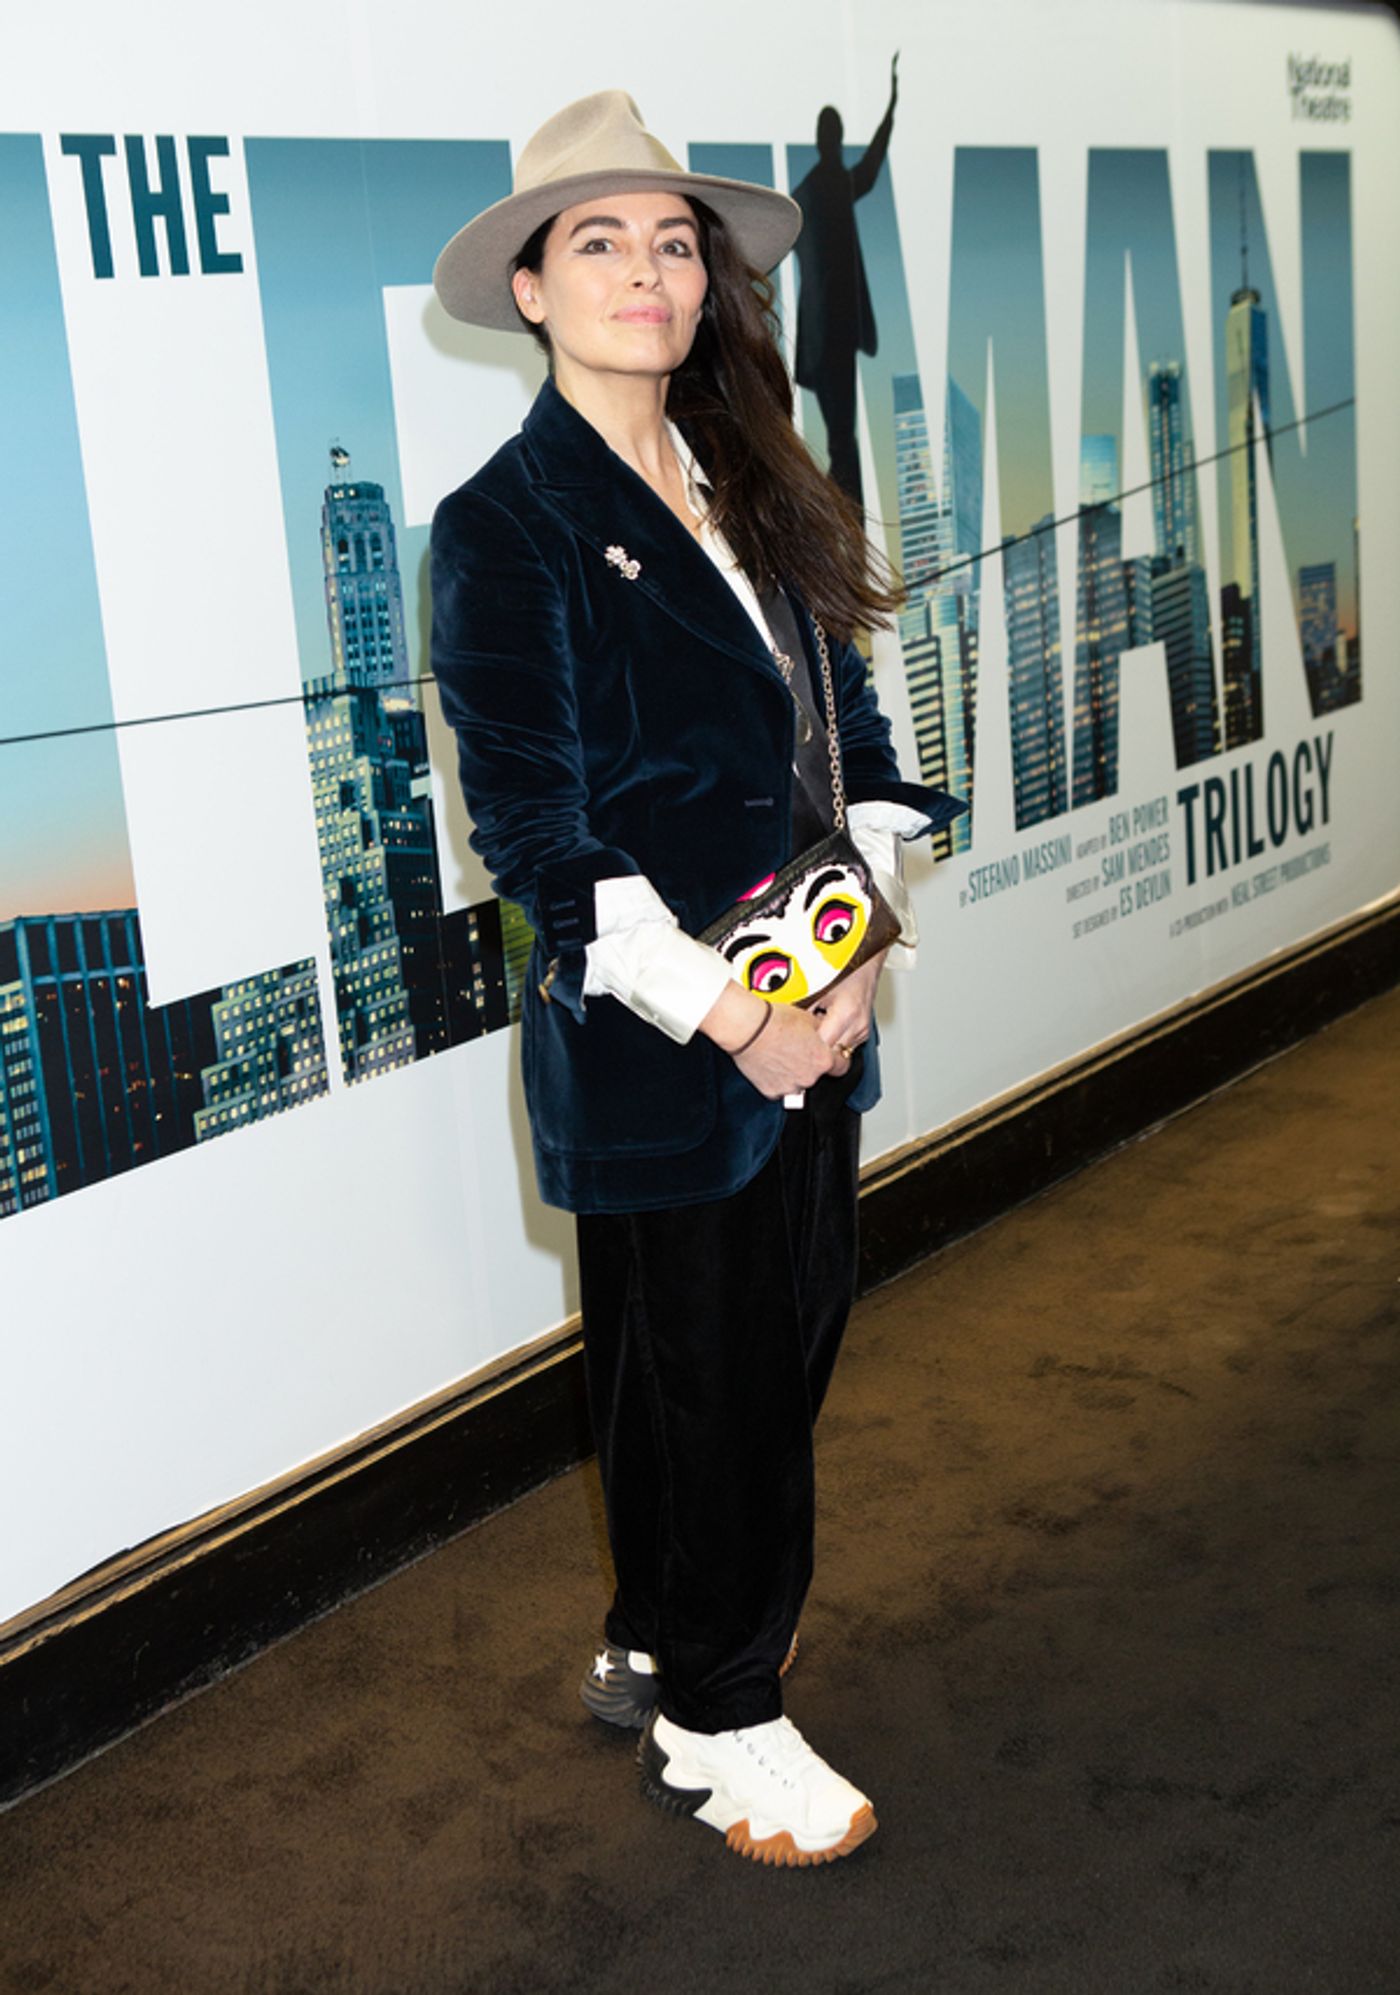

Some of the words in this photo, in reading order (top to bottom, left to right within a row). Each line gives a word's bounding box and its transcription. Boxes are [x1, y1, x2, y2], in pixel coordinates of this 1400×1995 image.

[59, 133, 244, 279] THE
[1109, 810, 1130, 846] BEN
[1132, 796, 1169, 837] POWER
[1176, 730, 1334, 887] TRILOGY
[968, 853, 1020, 904] STEFANO
[1022, 833, 1072, 882] MASSINI
[1102, 850, 1125, 888] SAM
[1127, 832, 1171, 876] MENDES
[1119, 884, 1133, 918] ES
[1135, 867, 1172, 911] DEVLIN
